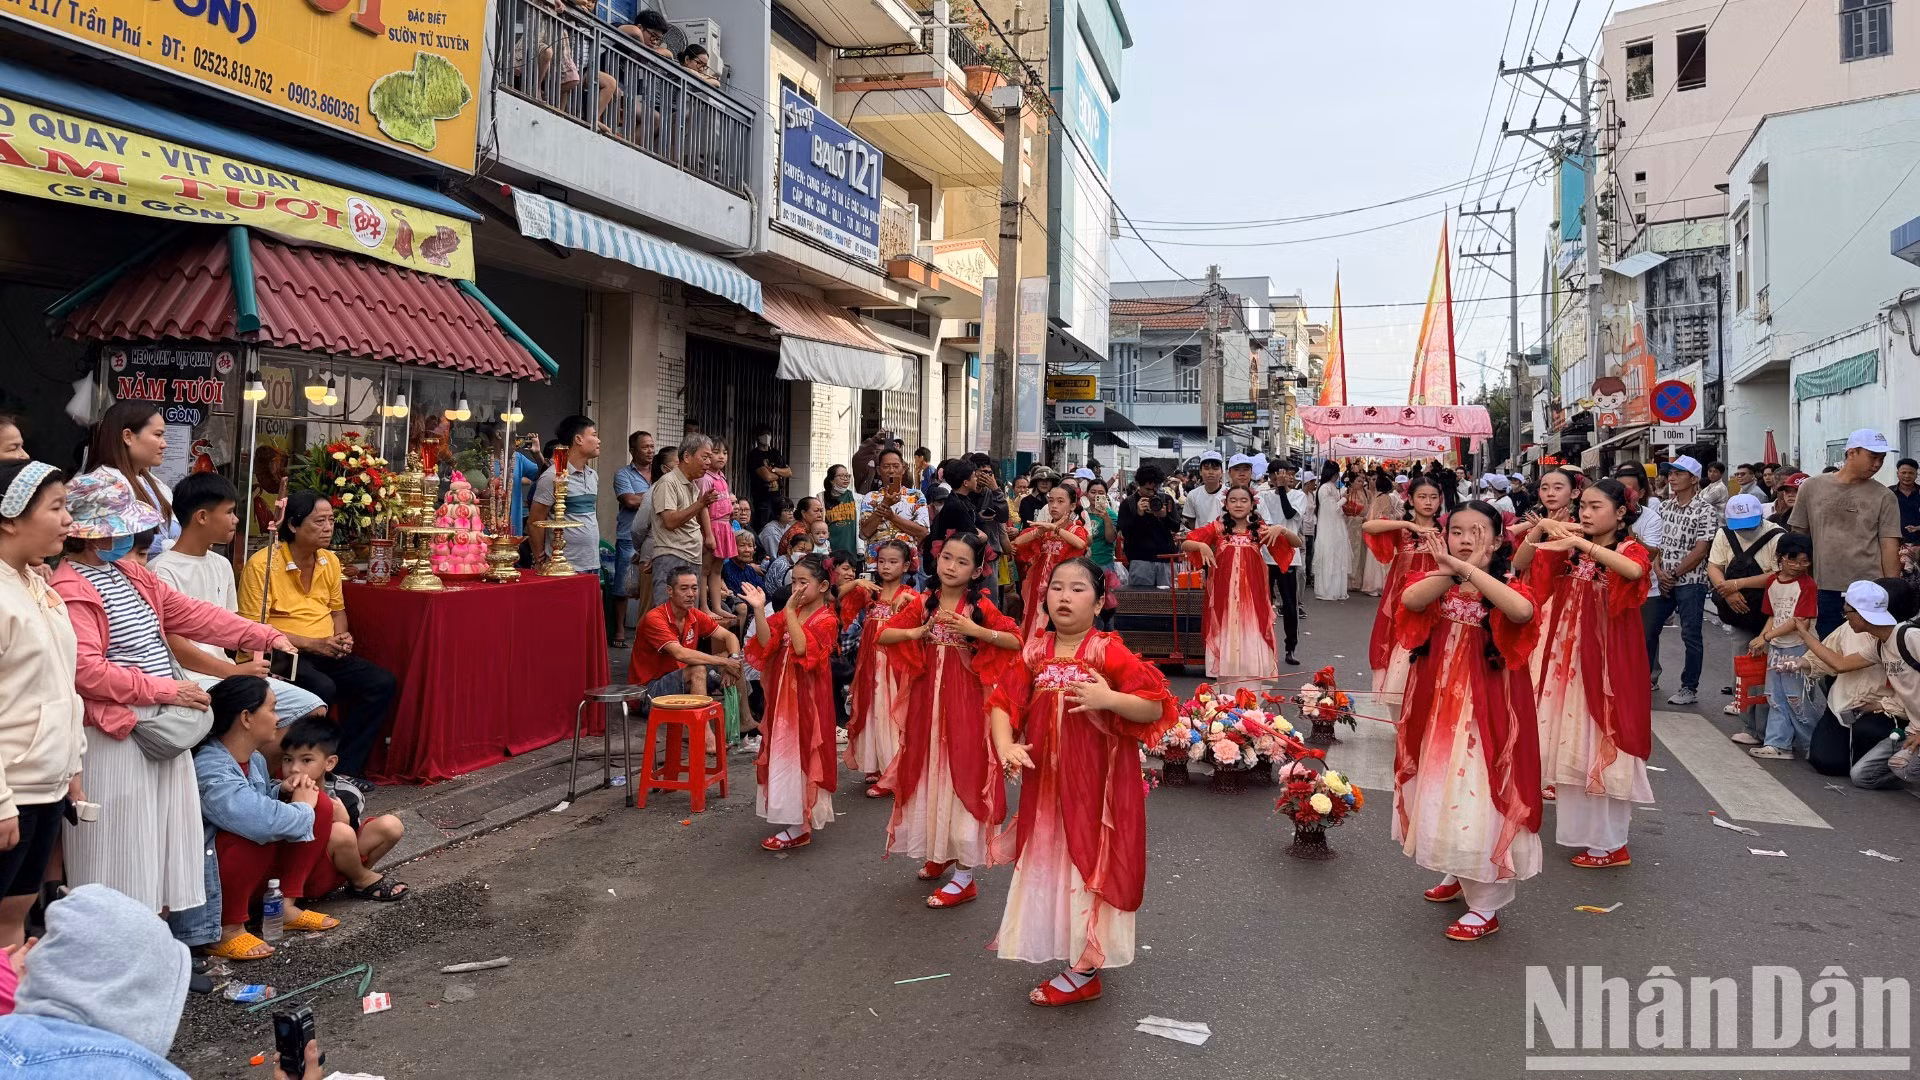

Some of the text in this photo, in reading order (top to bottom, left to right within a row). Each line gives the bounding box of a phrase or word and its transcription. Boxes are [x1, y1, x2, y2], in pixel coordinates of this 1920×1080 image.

[408, 8, 448, 27] ĐẶC BIỆT
[389, 26, 469, 51] SƯỜN TỨ XUYÊN
[69, 0, 106, 35] Trần
[112, 15, 142, 47] Phú
[162, 34, 186, 63] ĐT:
[193, 46, 273, 94] 02523.819.762
[288, 82, 360, 125] 0903.860361
[785, 102, 814, 131] Shop
[29, 113, 128, 156] QUAY
[160, 145, 211, 176] VỊT
[223, 162, 300, 191] QUAY
[846, 140, 878, 199] 121
[48, 183, 240, 222] (SÀI GÒN)
[160, 174, 343, 230] TƯƠI
[149, 351, 171, 366] QUAY
[191, 352, 213, 367] QUAY
[117, 371, 224, 404] NĂM TƯƠI
[166, 405, 200, 426] GÒN)
[1062, 406, 1084, 415] BIC
[1663, 430, 1684, 440] 100m
